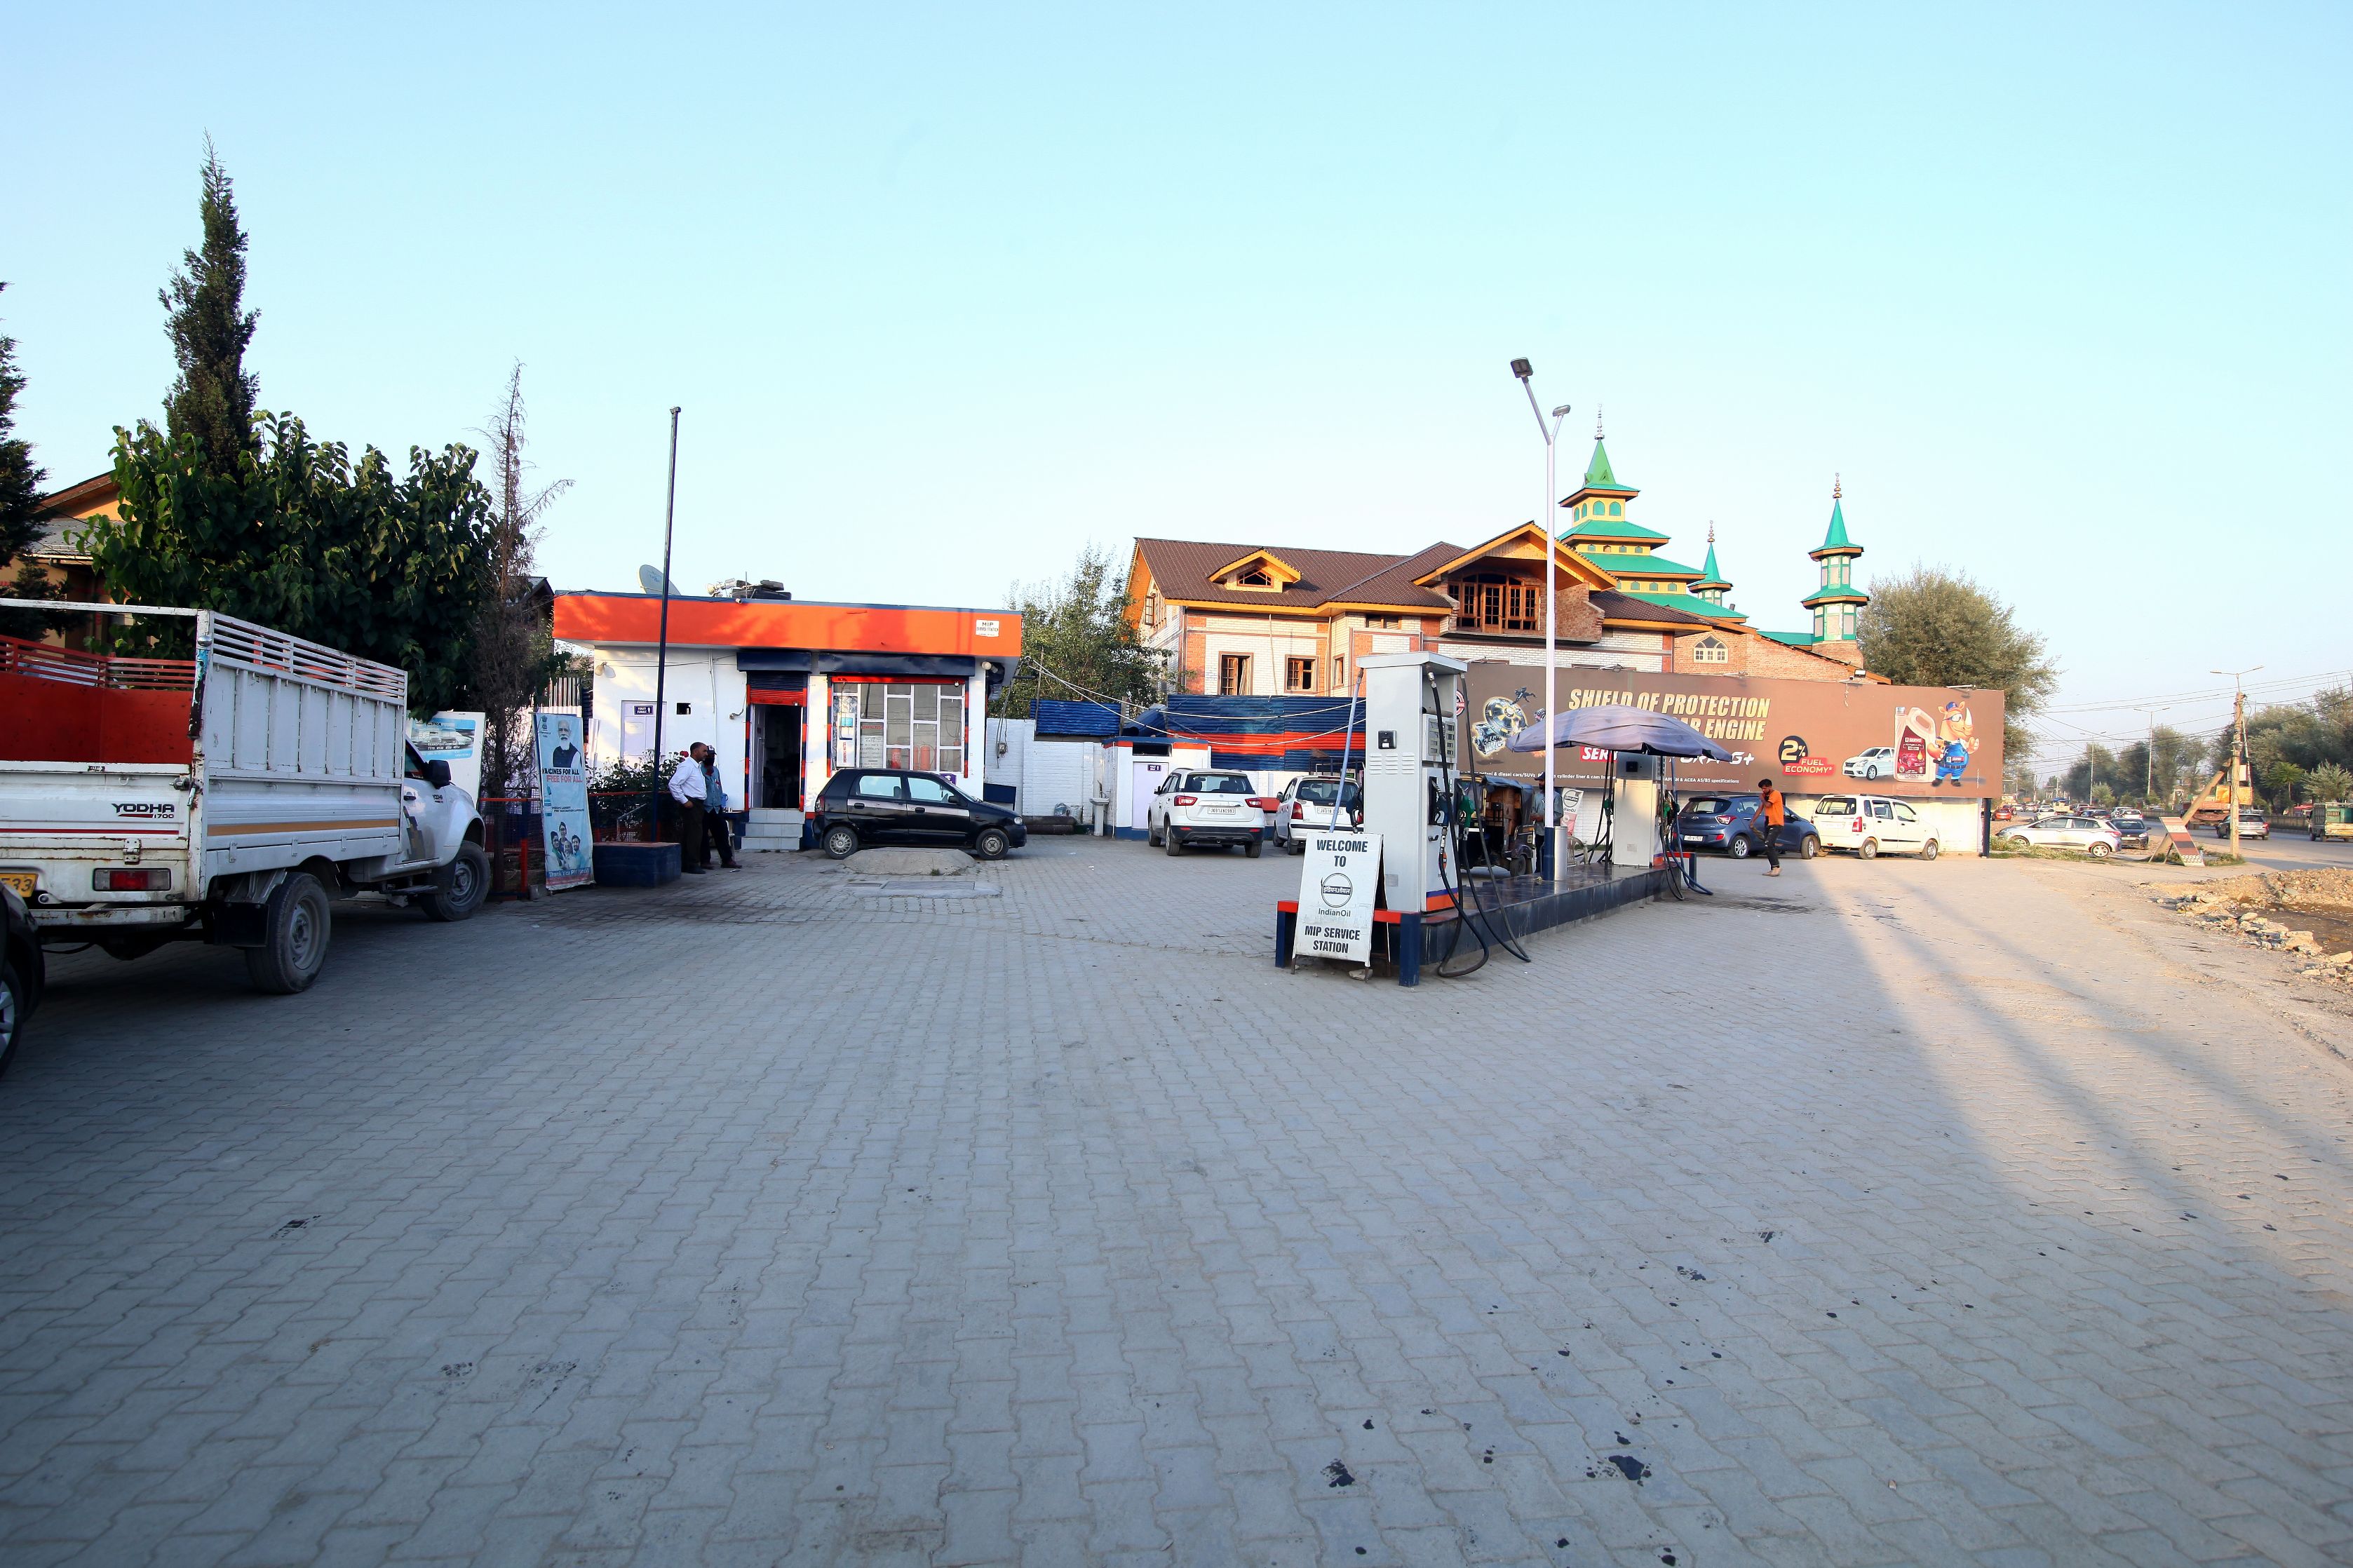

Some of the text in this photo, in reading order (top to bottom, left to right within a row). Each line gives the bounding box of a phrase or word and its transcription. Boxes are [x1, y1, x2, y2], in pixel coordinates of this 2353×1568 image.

[1568, 689, 1771, 718] SHIELD OF PROTECTION
[1704, 719, 1767, 741] ENGINE
[1582, 746, 1619, 761] SERV
[1781, 740, 1806, 761] 2%
[546, 774, 560, 783] FREE
[111, 803, 175, 813] YODHA
[1316, 839, 1368, 853] WELCOME
[1334, 856, 1347, 867] TO
[1319, 908, 1351, 917] IndianOil
[1304, 925, 1361, 940] MIP SERVICE
[1313, 940, 1349, 954] STATION
